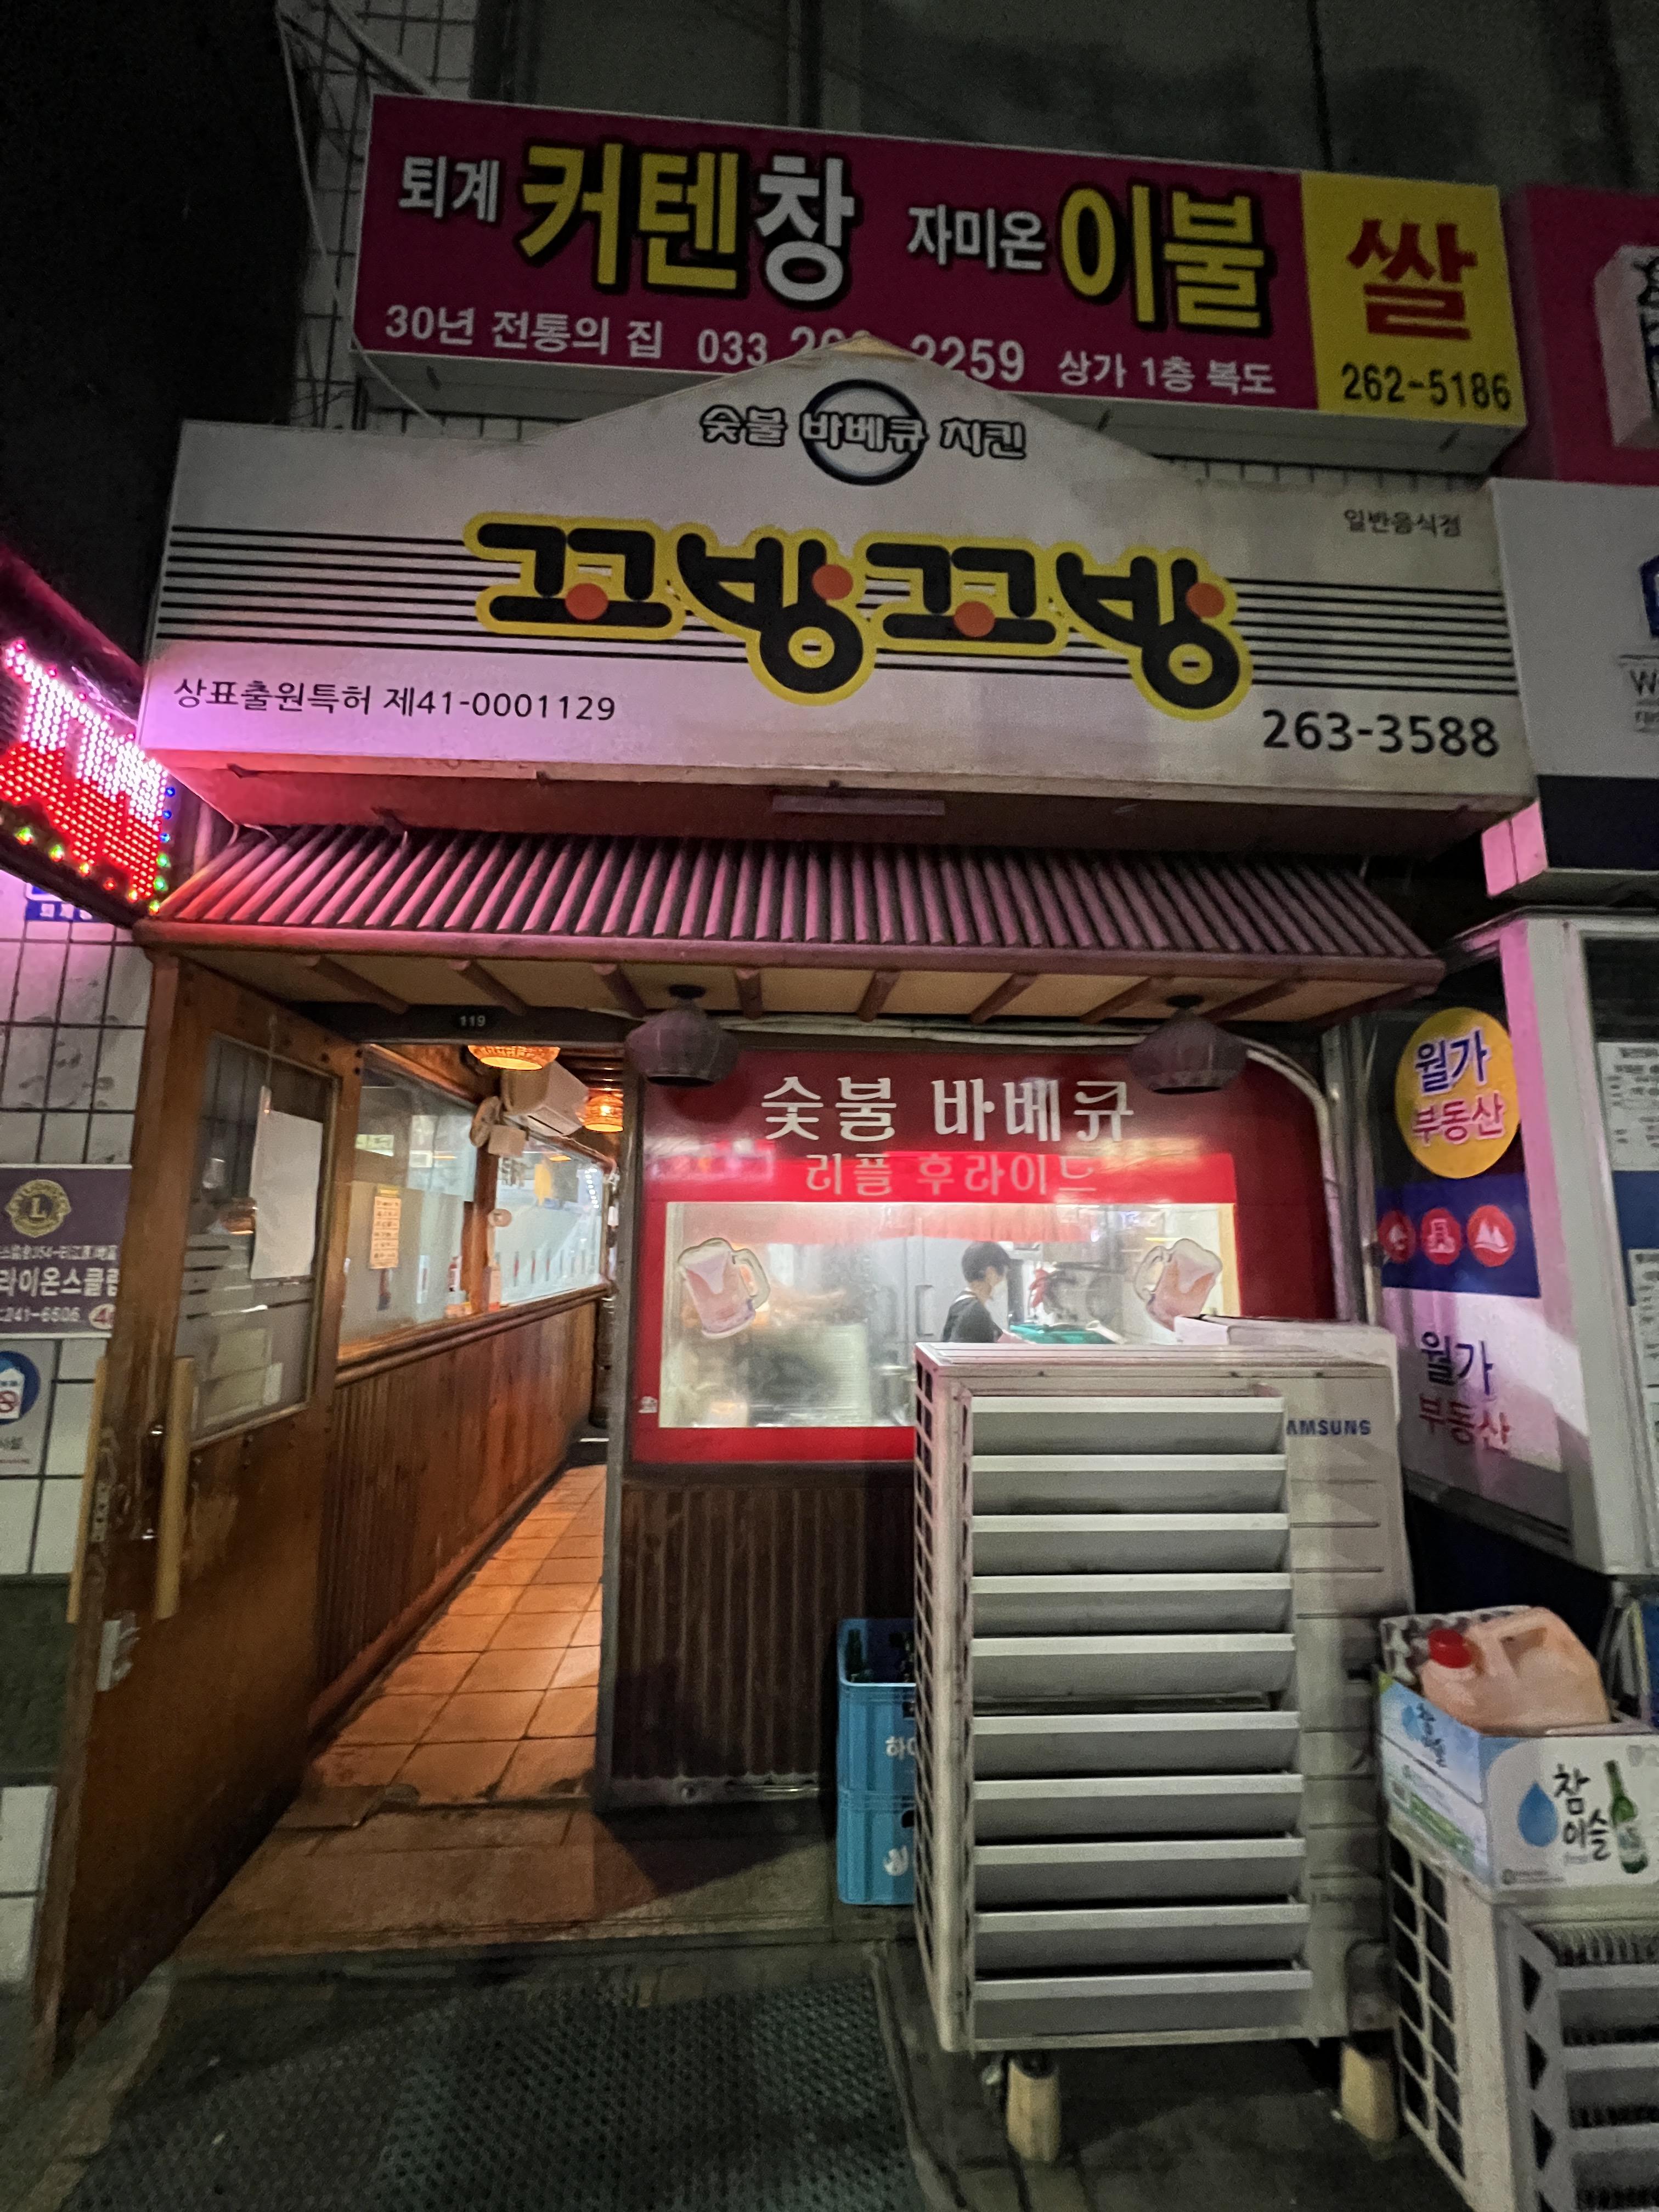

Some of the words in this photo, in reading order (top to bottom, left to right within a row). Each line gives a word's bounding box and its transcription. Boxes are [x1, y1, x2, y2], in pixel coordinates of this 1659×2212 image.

[398, 155, 499, 223] 퇴계
[518, 143, 855, 303] 커텐창
[906, 204, 1047, 270] 자미온
[1060, 184, 1265, 329] 이불
[1347, 218, 1477, 340] 쌀
[385, 304, 476, 346] 30년
[492, 311, 610, 356] 전통의
[627, 320, 663, 359] 집
[697, 329, 768, 366] 033
[1059, 350, 1127, 389] 상가
[1141, 356, 1195, 393] 1층
[1207, 359, 1277, 396] 복도
[1341, 363, 1512, 411] 262-5186
[799, 411, 930, 454] 바베큐
[940, 416, 1026, 460] 치킨
[1344, 509, 1462, 539] 일반음식점
[173, 676, 371, 714] 상표출원특허
[383, 686, 616, 722] 제41-0001129
[1262, 708, 1500, 758] 263-3588
[460, 1015, 486, 1026] 119
[1415, 1030, 1488, 1093] 월가
[931, 1078, 1134, 1142] 바베큐
[1412, 1092, 1504, 1144] 부동산
[805, 1153, 893, 1197] 리플
[917, 1153, 1098, 1197] 후라이드
[1420, 1331, 1494, 1396] 월가
[1286, 1419, 1372, 1436] AMSUNG
[1419, 1394, 1511, 1455] 부동산
[1553, 1763, 1612, 1861] 참이슬
